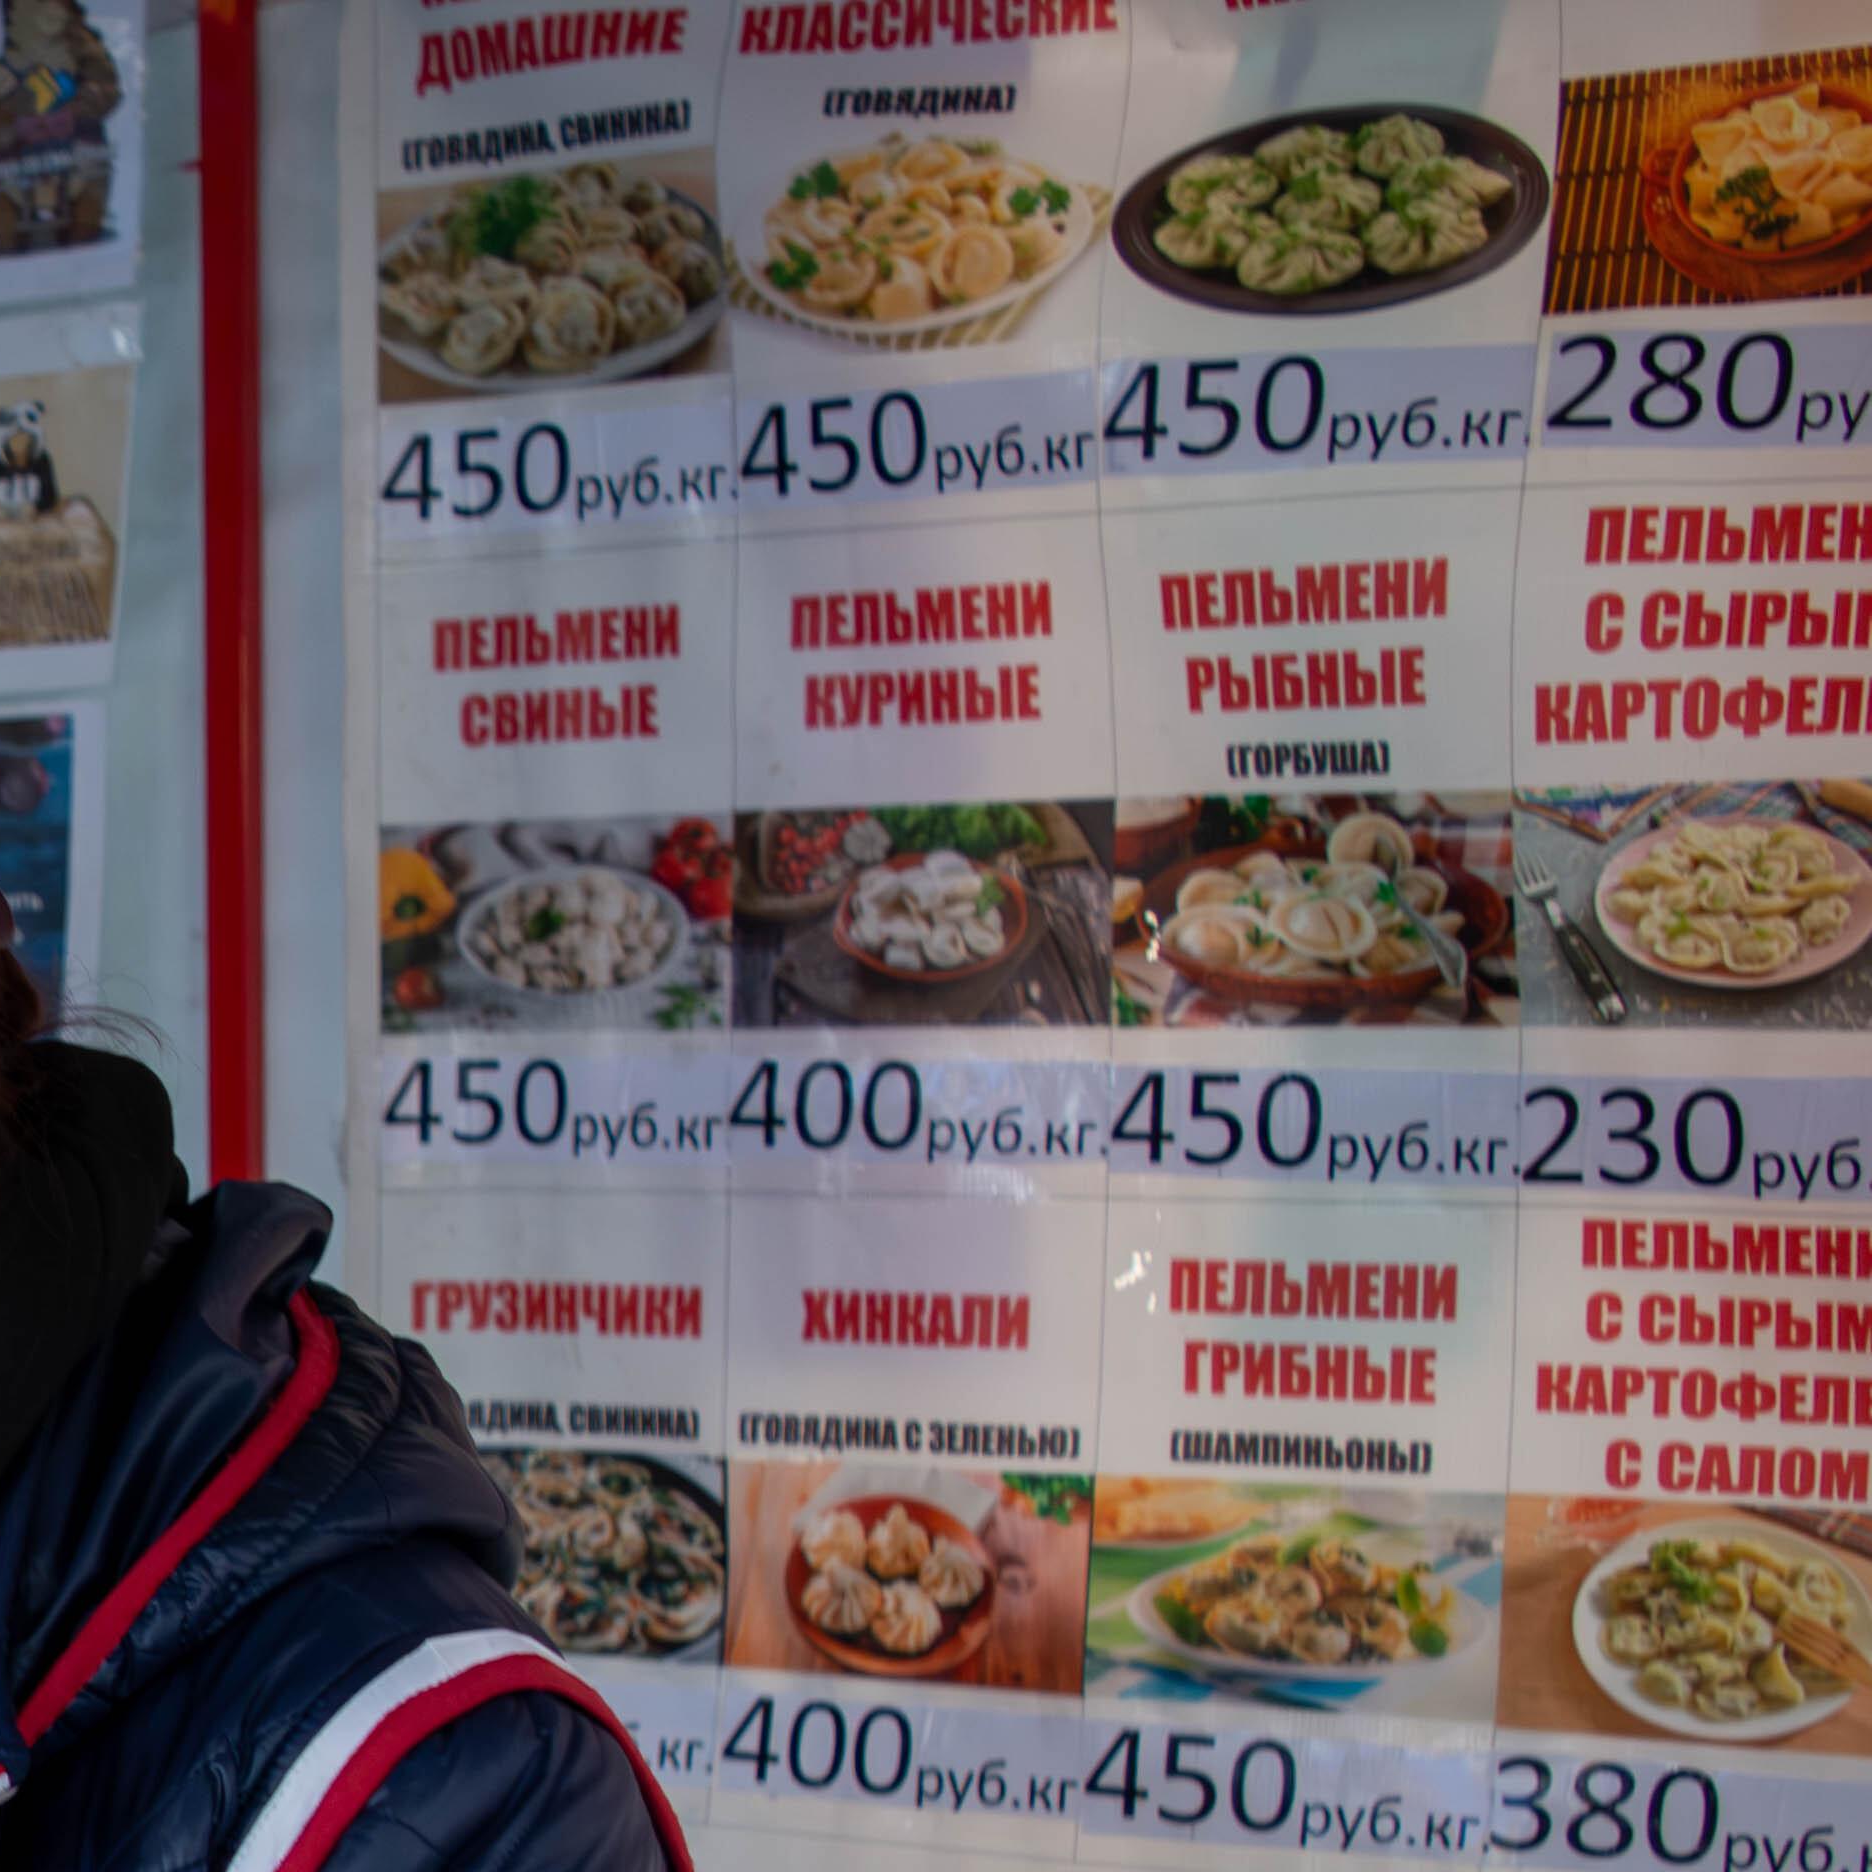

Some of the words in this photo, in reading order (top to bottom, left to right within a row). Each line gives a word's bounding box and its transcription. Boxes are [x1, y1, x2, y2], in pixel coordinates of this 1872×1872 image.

[415, 8, 688, 98] ДОМАШНИЕ
[737, 0, 1120, 56] КЛАССИЧЕСКИЕ
[559, 98, 692, 150] СВИНИНА)
[822, 84, 1017, 119] (ГОВЯДИНА)
[1584, 503, 1872, 565] ПЕЛЬМЕН
[790, 580, 1053, 651] ПЕЛЬМЕНИ
[1159, 556, 1449, 633] ПЕЛЬМЕНИ
[1583, 591, 1624, 654] С
[1640, 590, 1872, 652] СЫРЫ
[433, 604, 681, 672] ПЕЛЬМЕНИ
[804, 664, 1042, 731] КУРИНЫЕ
[1185, 646, 1427, 715] РЫБНЫЕ
[1534, 675, 1872, 746] КАРТОФЕЛ
[460, 684, 660, 748] СВИНЫЕ
[1226, 740, 1392, 779] (ГОРБУША)
[410, 1279, 704, 1339] ГРУЗИНЧИКИ
[802, 1287, 1031, 1351] ХИНКАЛИ
[1168, 1257, 1458, 1323] ПЕЛЬМЕНИ
[1584, 1290, 1623, 1343] С
[1183, 1338, 1437, 1404] ГРИБНЫЕ
[740, 1410, 899, 1454] (ГОВЯДИНА
[905, 1419, 924, 1453] С
[927, 1420, 1082, 1460] ЗЕЛЕНЬЮ)
[1169, 1427, 1434, 1476] (ШАМПИНЬОНЫ)
[1603, 1438, 1643, 1491] С
[1656, 1440, 1870, 1504] САЛОМ
